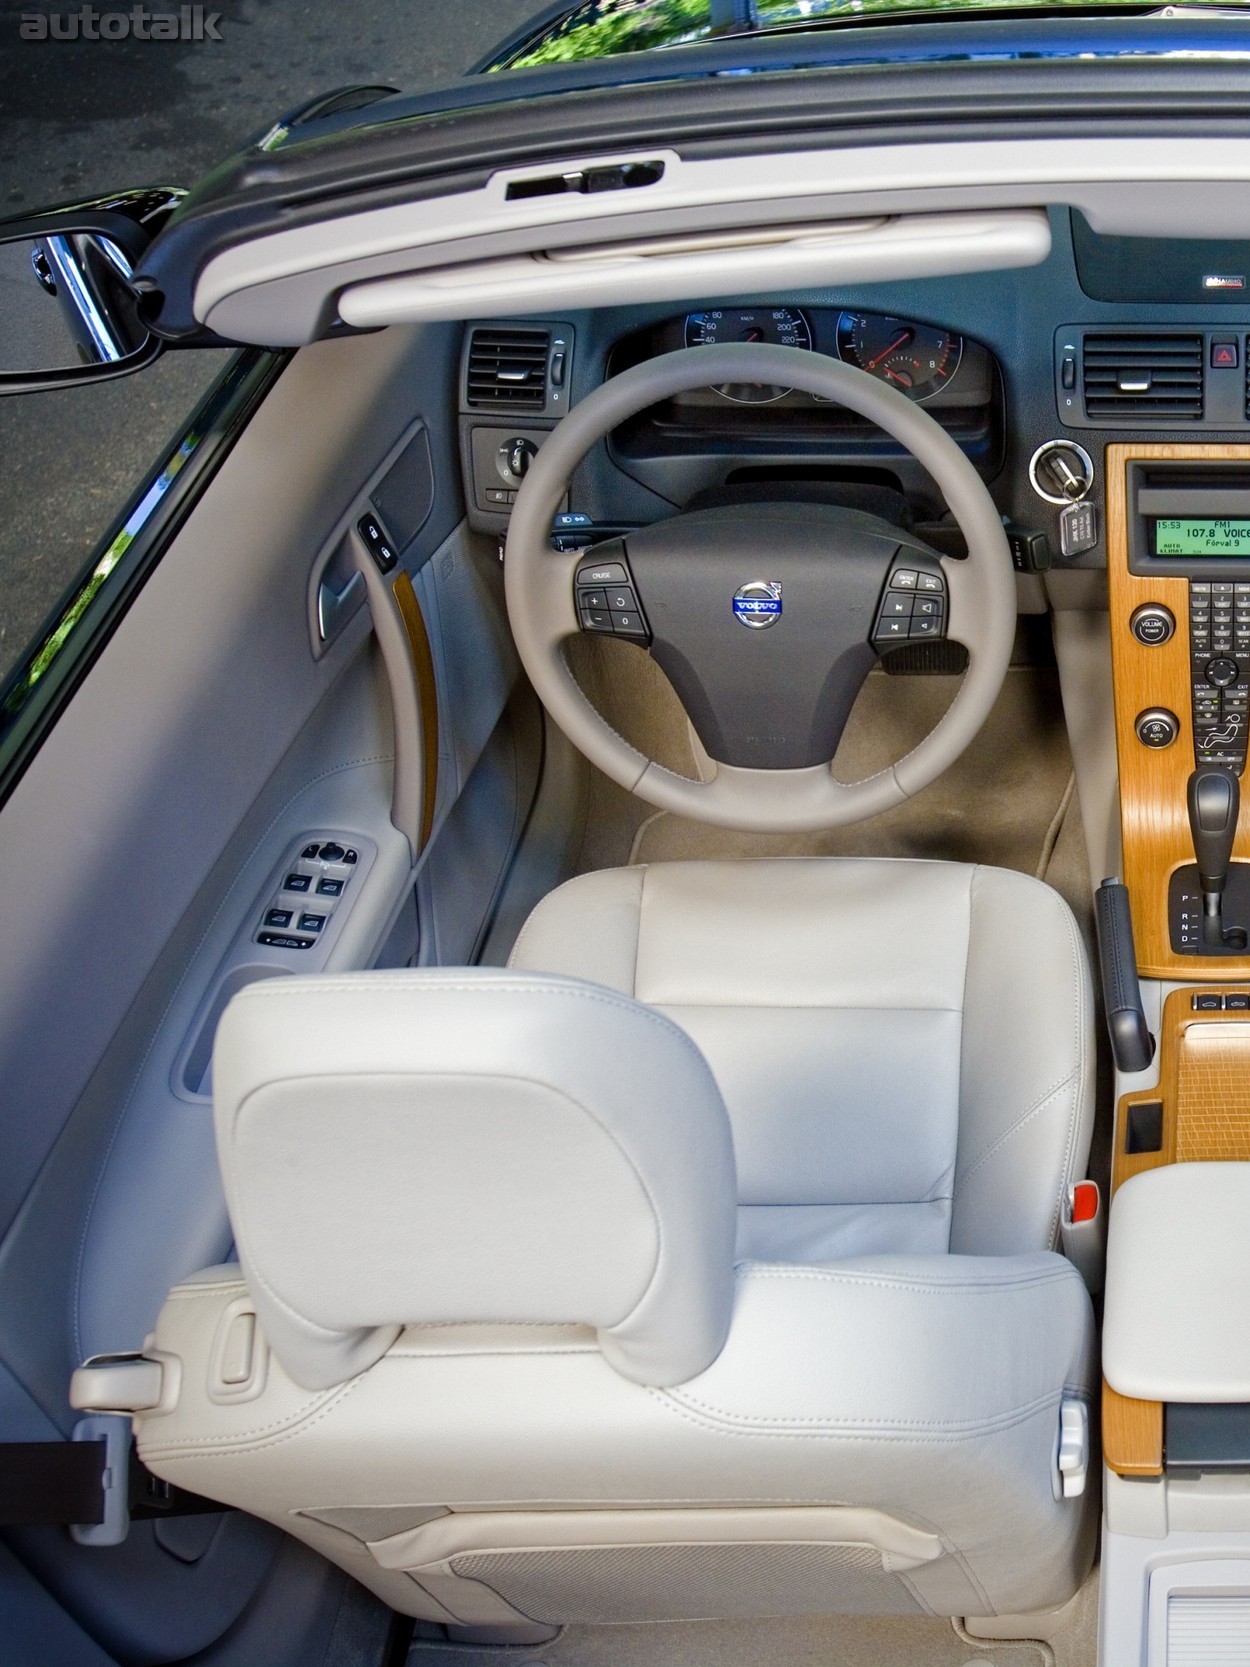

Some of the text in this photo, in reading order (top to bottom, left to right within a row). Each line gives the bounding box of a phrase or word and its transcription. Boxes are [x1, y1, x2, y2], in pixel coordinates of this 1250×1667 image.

[777, 323, 791, 331] 200
[1158, 521, 1181, 529] 15:53
[1187, 529, 1215, 538] 107.8
[737, 601, 778, 611] VOLVO
